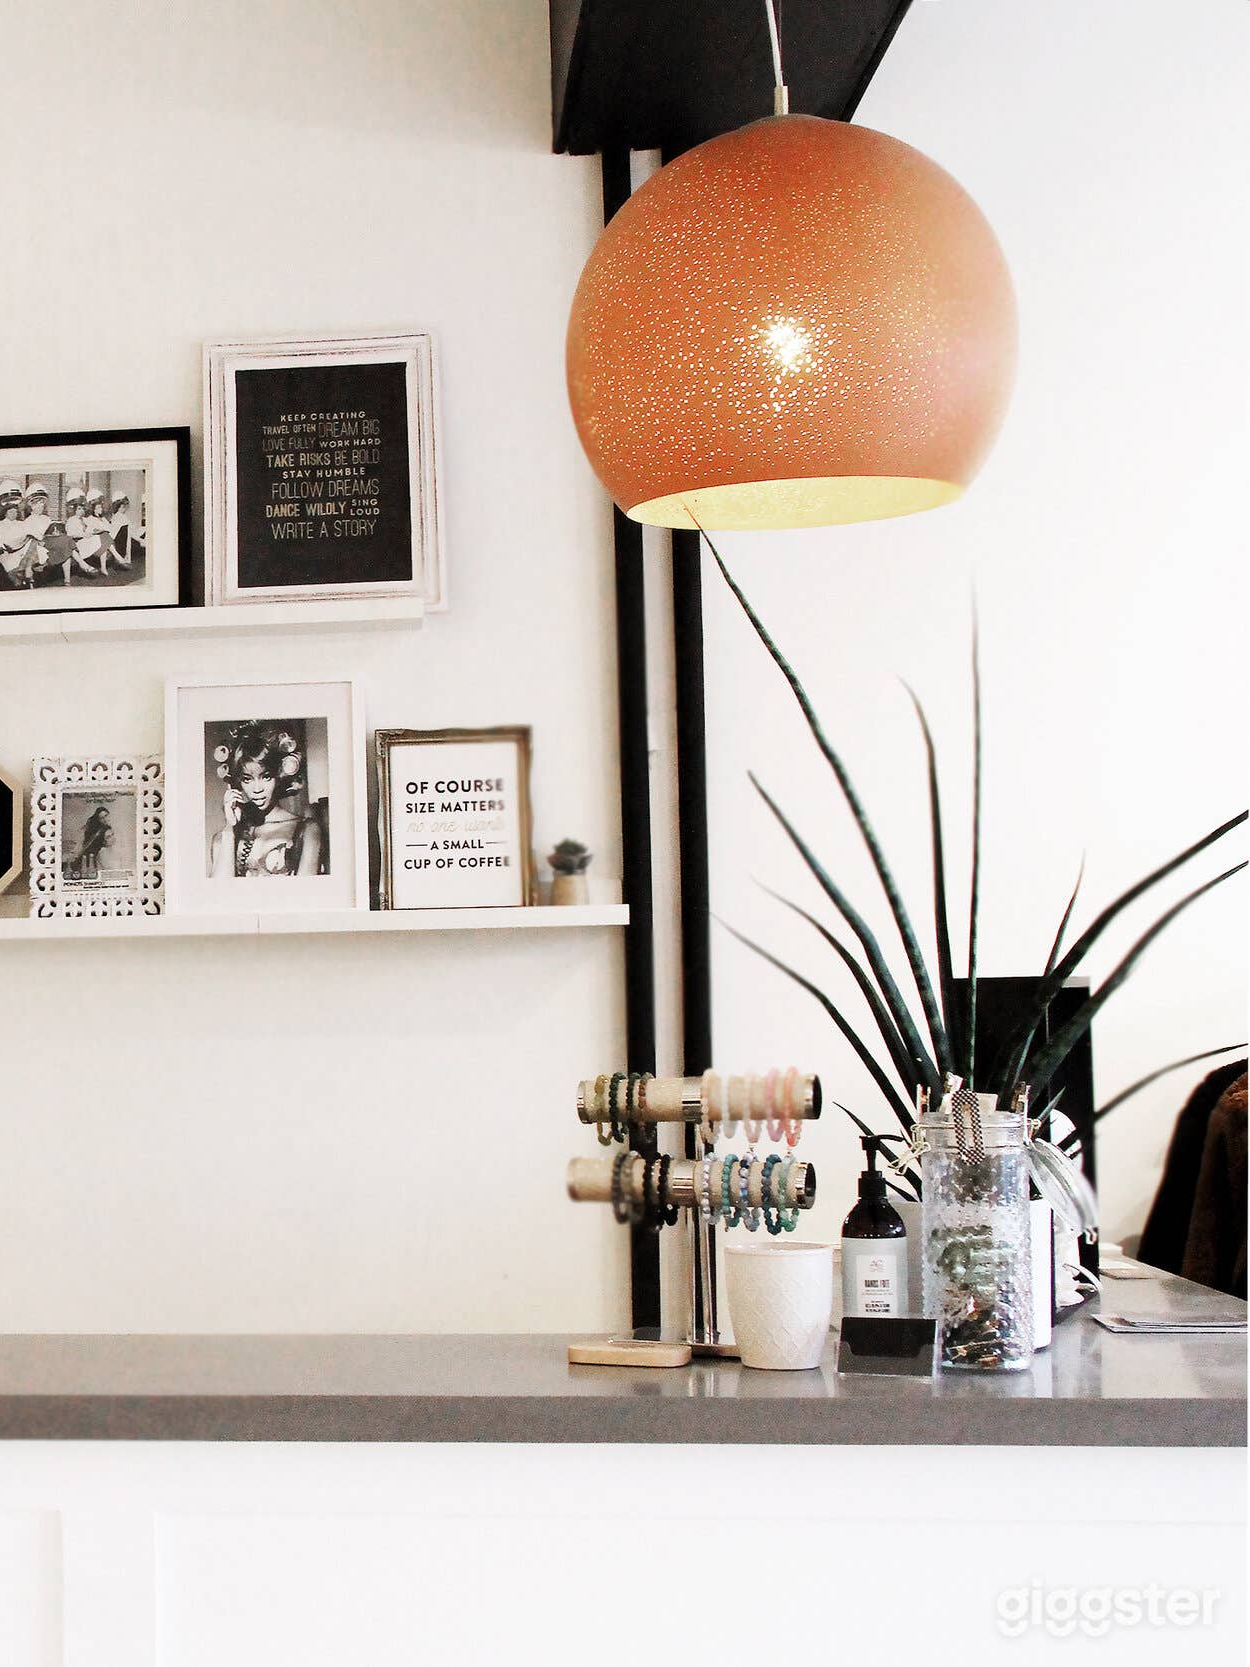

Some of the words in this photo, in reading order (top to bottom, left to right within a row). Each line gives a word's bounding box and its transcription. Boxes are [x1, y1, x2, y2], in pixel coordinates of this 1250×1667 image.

[280, 414, 306, 422] KEEP
[310, 411, 366, 421] CREATING
[262, 425, 290, 435] TRAVEL
[293, 423, 317, 434] OFTEN
[318, 421, 359, 438] DREAM
[362, 419, 380, 436] BIG
[288, 437, 317, 449] FULLY
[319, 440, 350, 449] WORK
[353, 438, 381, 446] HARD
[266, 453, 295, 468] TAKE
[299, 452, 332, 466] RISKS
[334, 450, 348, 466] BE
[351, 449, 380, 465] BOLD
[282, 470, 312, 479] STAY
[316, 467, 366, 478] HUMBLE
[271, 482, 324, 500] FOLLOW
[328, 478, 380, 498] DREAMS
[265, 503, 301, 518] DANCE
[305, 501, 347, 517] WILDLY
[351, 499, 378, 507] SING
[350, 507, 380, 516] LOUD
[271, 522, 314, 539] WRITE
[319, 521, 329, 538] A
[333, 519, 377, 538] STORY
[405, 782, 429, 795] OF
[434, 778, 504, 794] COURSE
[405, 802, 435, 814] SIZE
[441, 800, 505, 813] MATTERS
[430, 841, 439, 850] A
[443, 839, 485, 850] SMALL
[404, 859, 431, 870] CUP
[435, 858, 454, 869] OF
[458, 856, 510, 868] COFFEE
